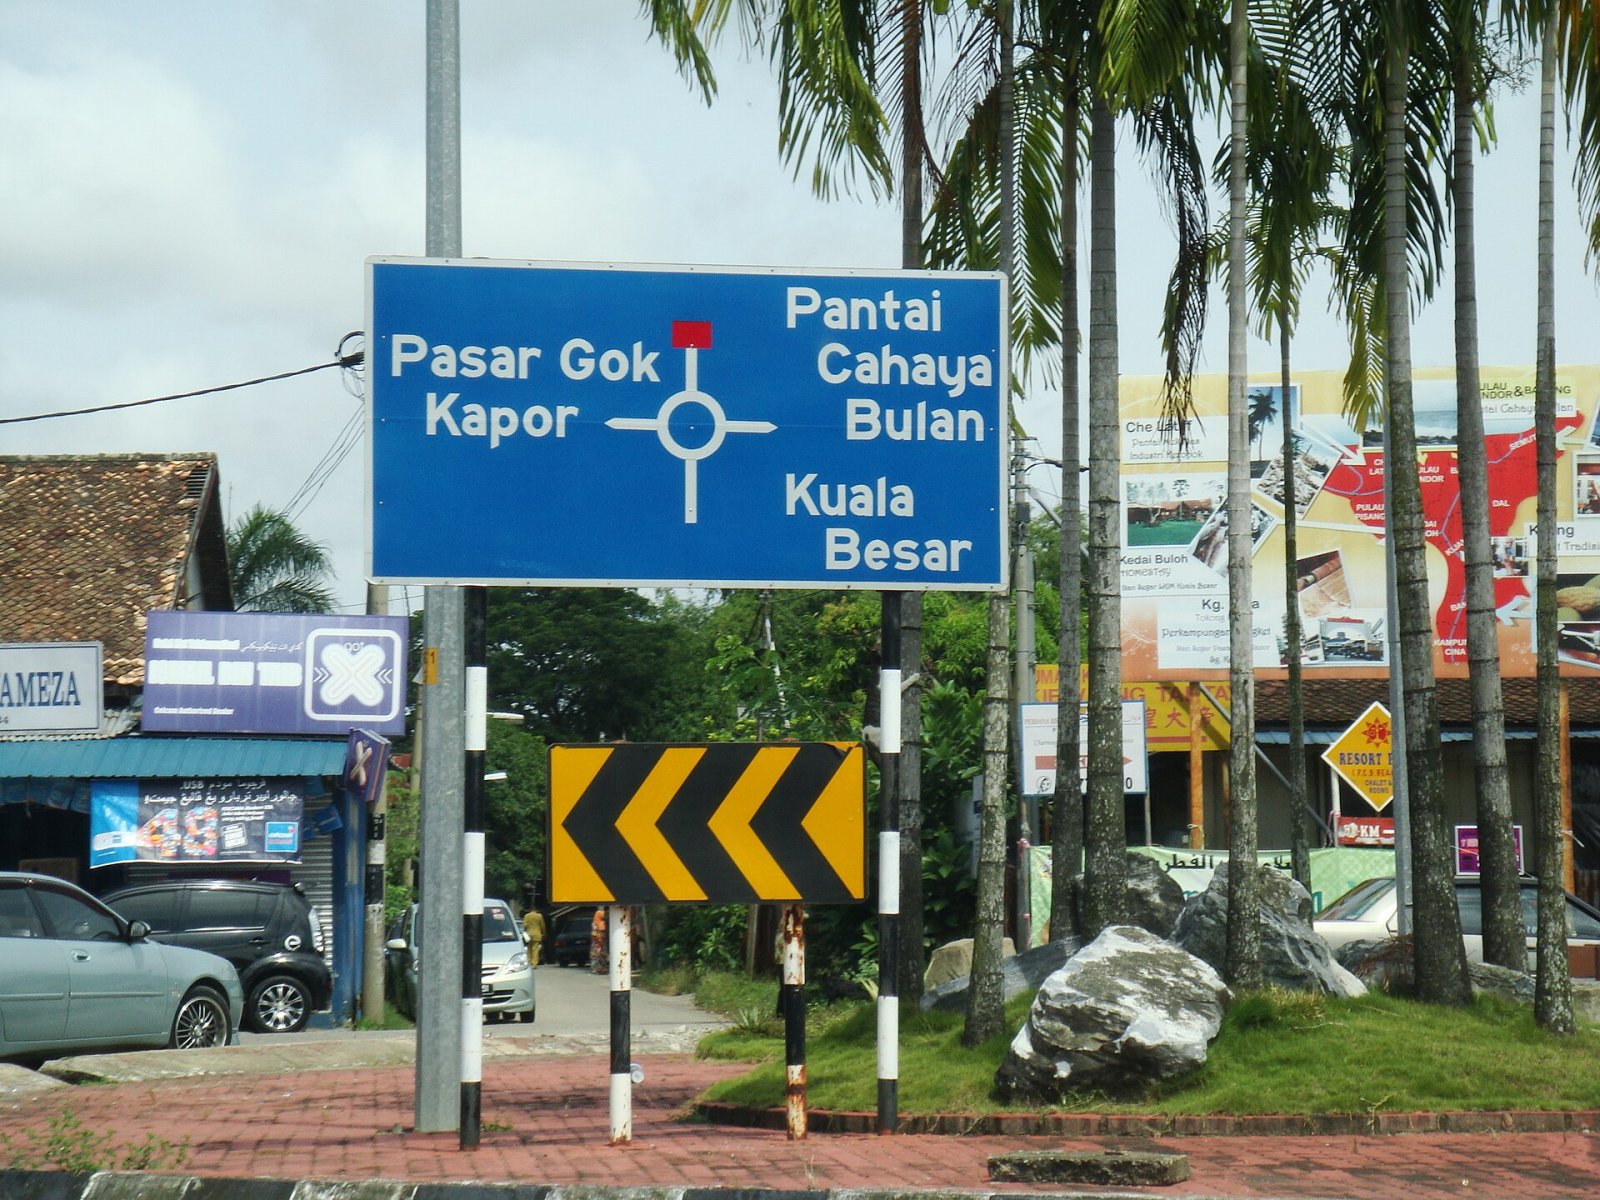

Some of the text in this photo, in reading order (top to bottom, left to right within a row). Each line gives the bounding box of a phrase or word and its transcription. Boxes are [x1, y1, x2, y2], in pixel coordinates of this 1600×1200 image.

[788, 287, 940, 331] Pantai
[393, 335, 660, 381] Pasar Gok
[818, 343, 991, 397] Cahaya
[427, 393, 578, 448] Kapor
[847, 399, 983, 441] Bulan
[1126, 421, 1153, 432] Che
[787, 474, 913, 516] Kuala
[827, 528, 972, 571] Besar
[1155, 554, 1188, 564] Buloh
[1202, 599, 1224, 612] Kg.
[1444, 648, 1466, 656] CINA
[0, 672, 81, 707] AMEZA
[1339, 753, 1382, 766] RESORT
[1360, 825, 1380, 837] KM
